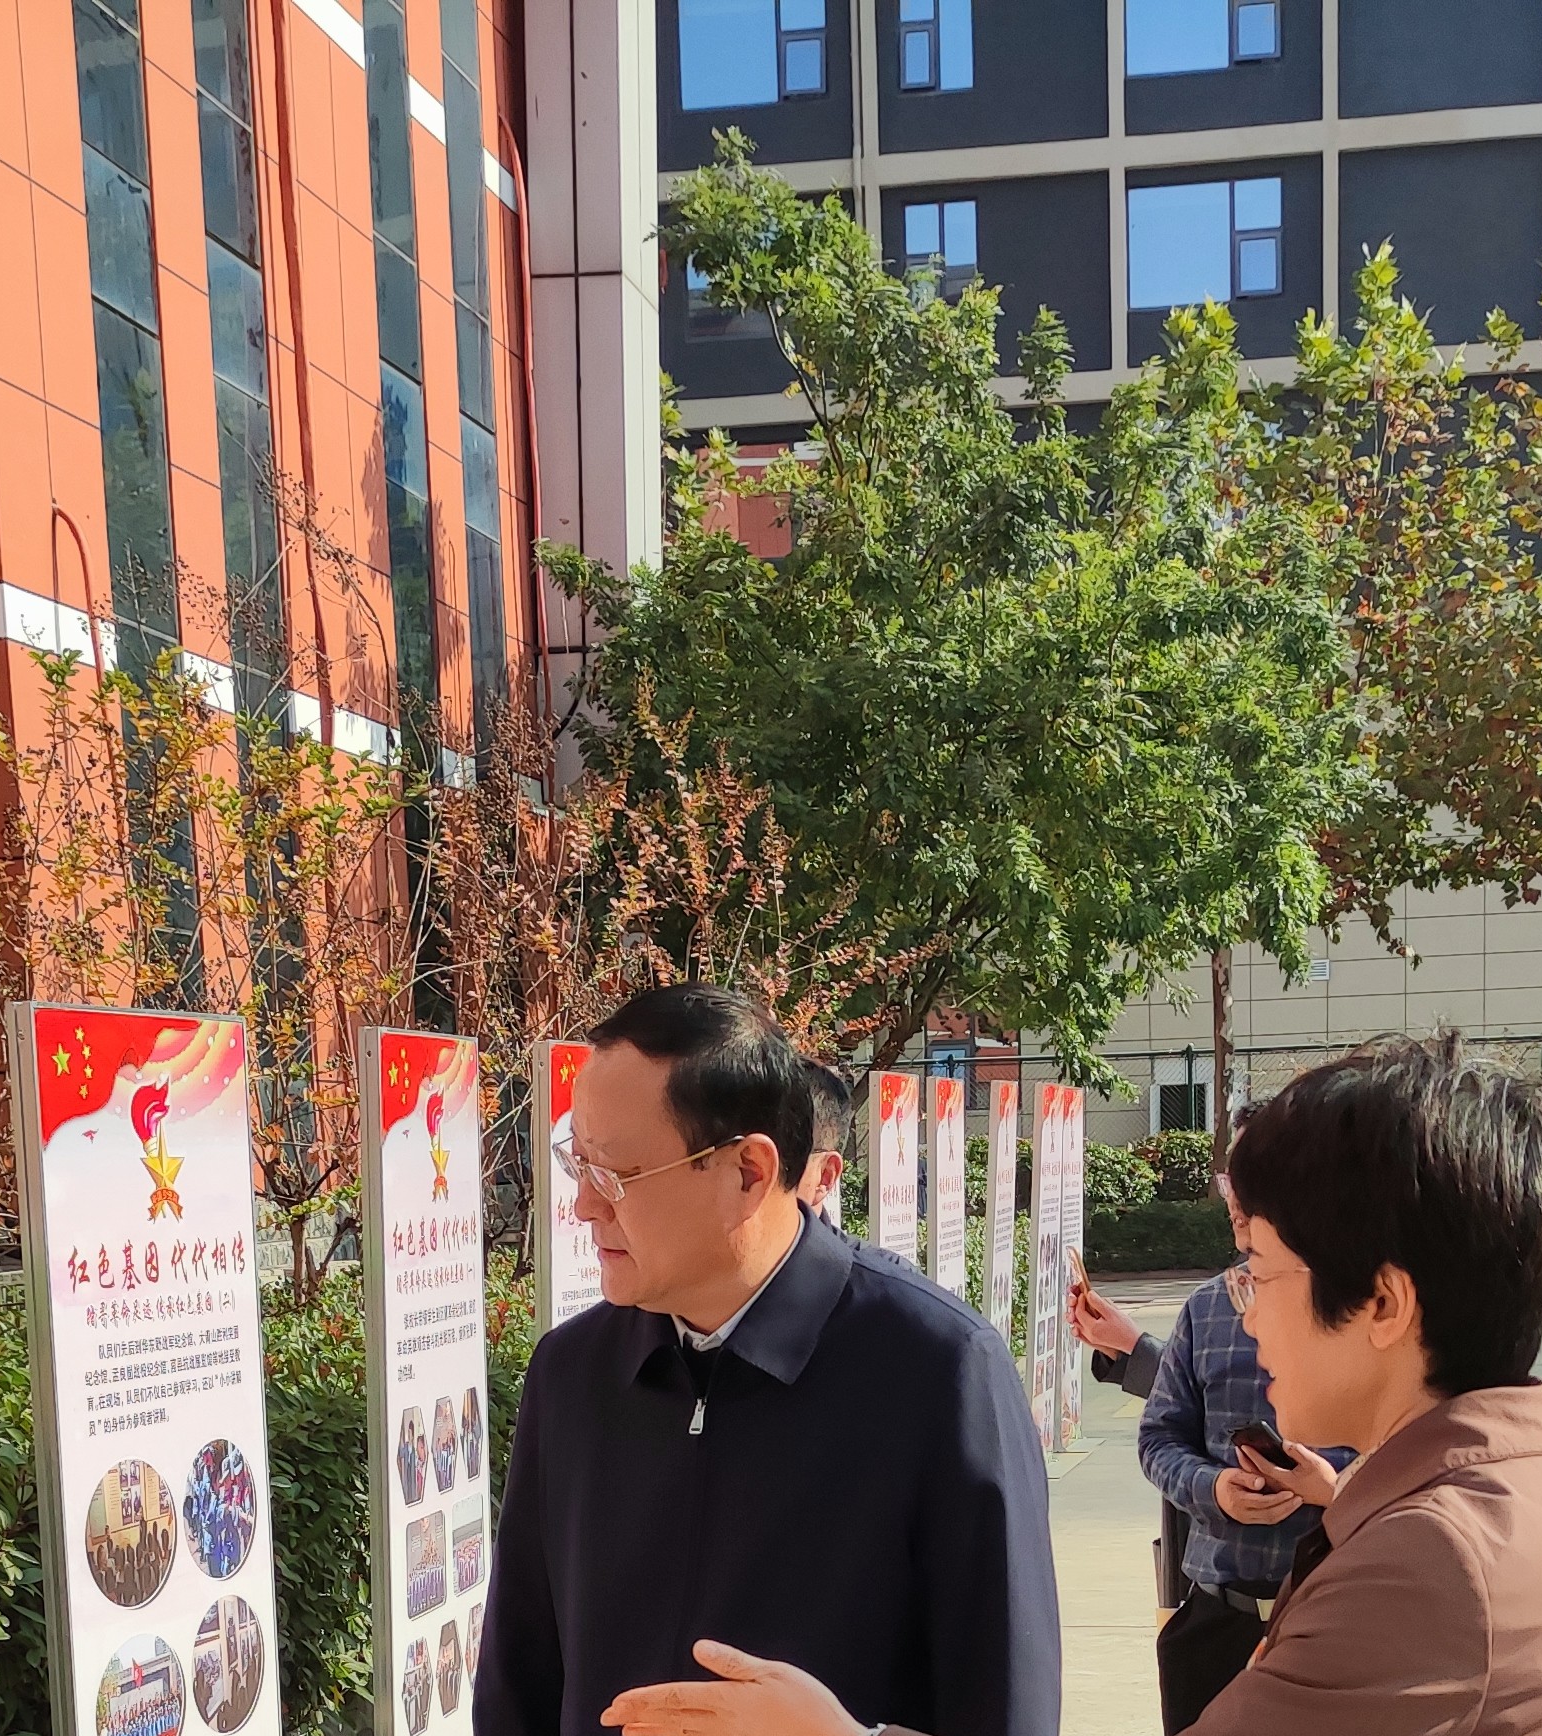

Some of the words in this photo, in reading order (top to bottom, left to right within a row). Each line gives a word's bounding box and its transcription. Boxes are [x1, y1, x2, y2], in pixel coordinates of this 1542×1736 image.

[67, 1239, 160, 1294] 红色基因
[171, 1231, 246, 1284] 代代相传
[393, 1215, 438, 1259] 红色基因
